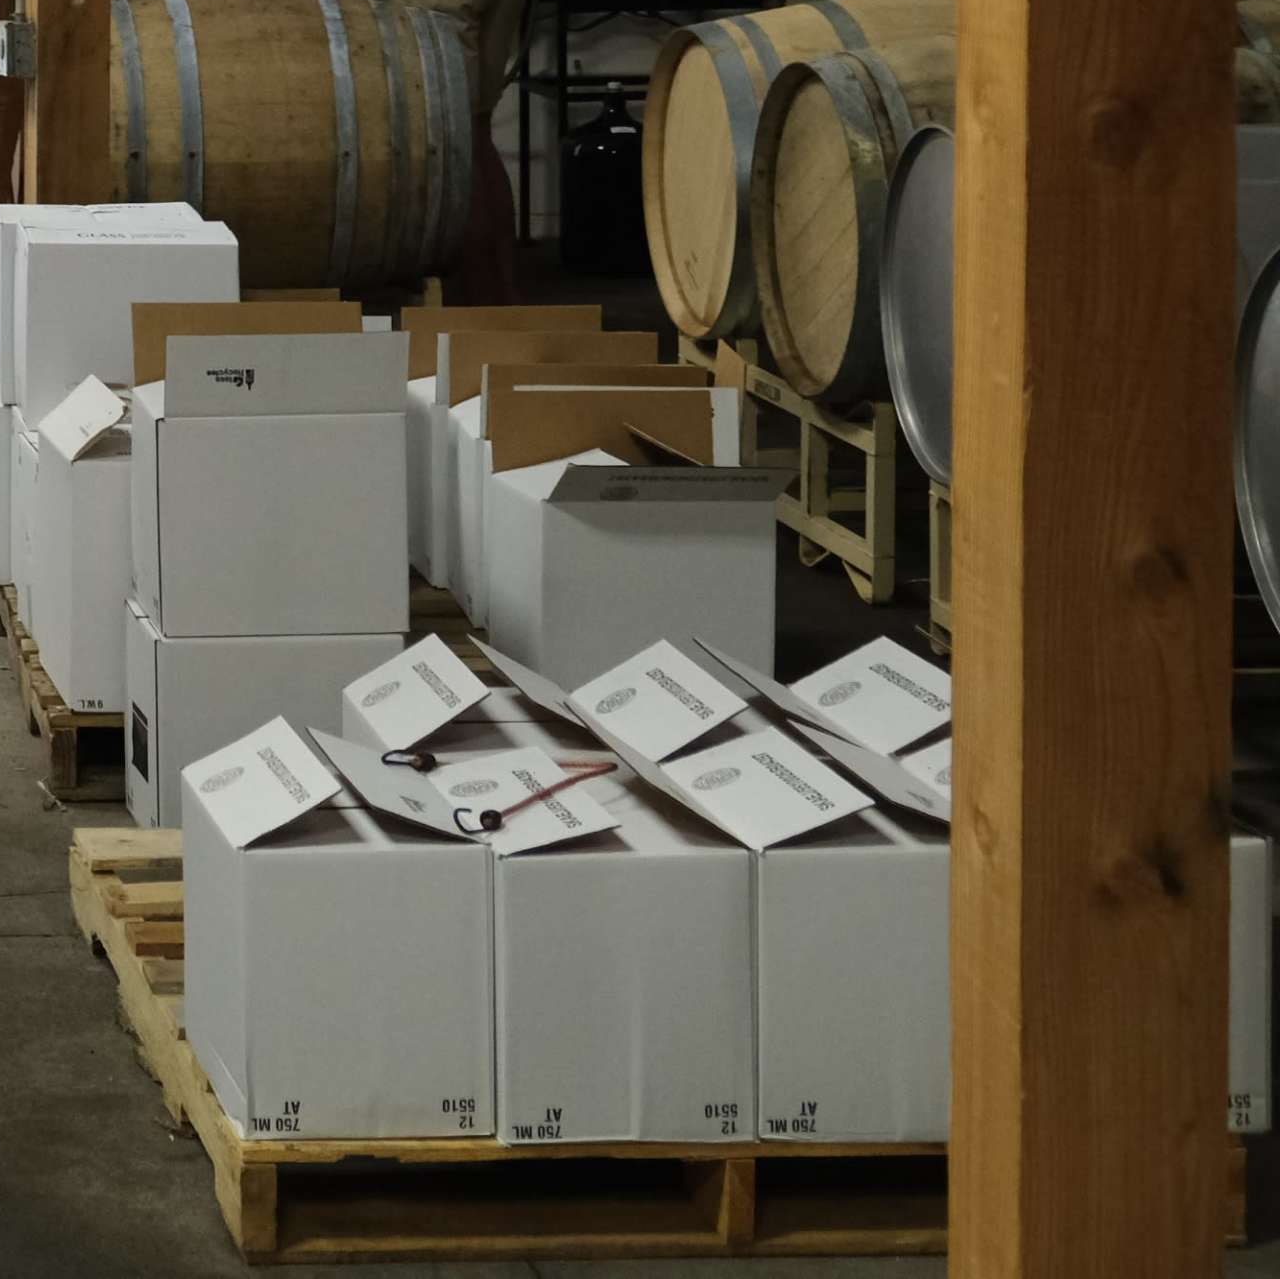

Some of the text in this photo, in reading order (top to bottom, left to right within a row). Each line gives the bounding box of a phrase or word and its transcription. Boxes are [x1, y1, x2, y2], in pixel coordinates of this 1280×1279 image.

[283, 1101, 301, 1115] AT
[442, 1098, 476, 1113] 5510
[705, 1104, 738, 1118] 5510
[800, 1101, 817, 1116] AT
[458, 1115, 476, 1129] 12
[544, 1108, 562, 1122] AT
[1235, 1112, 1251, 1127] 12
[251, 1118, 300, 1131] 750 ML
[721, 1121, 737, 1134] 12
[767, 1118, 816, 1133] 750 ML
[512, 1125, 562, 1139] 750 ML
